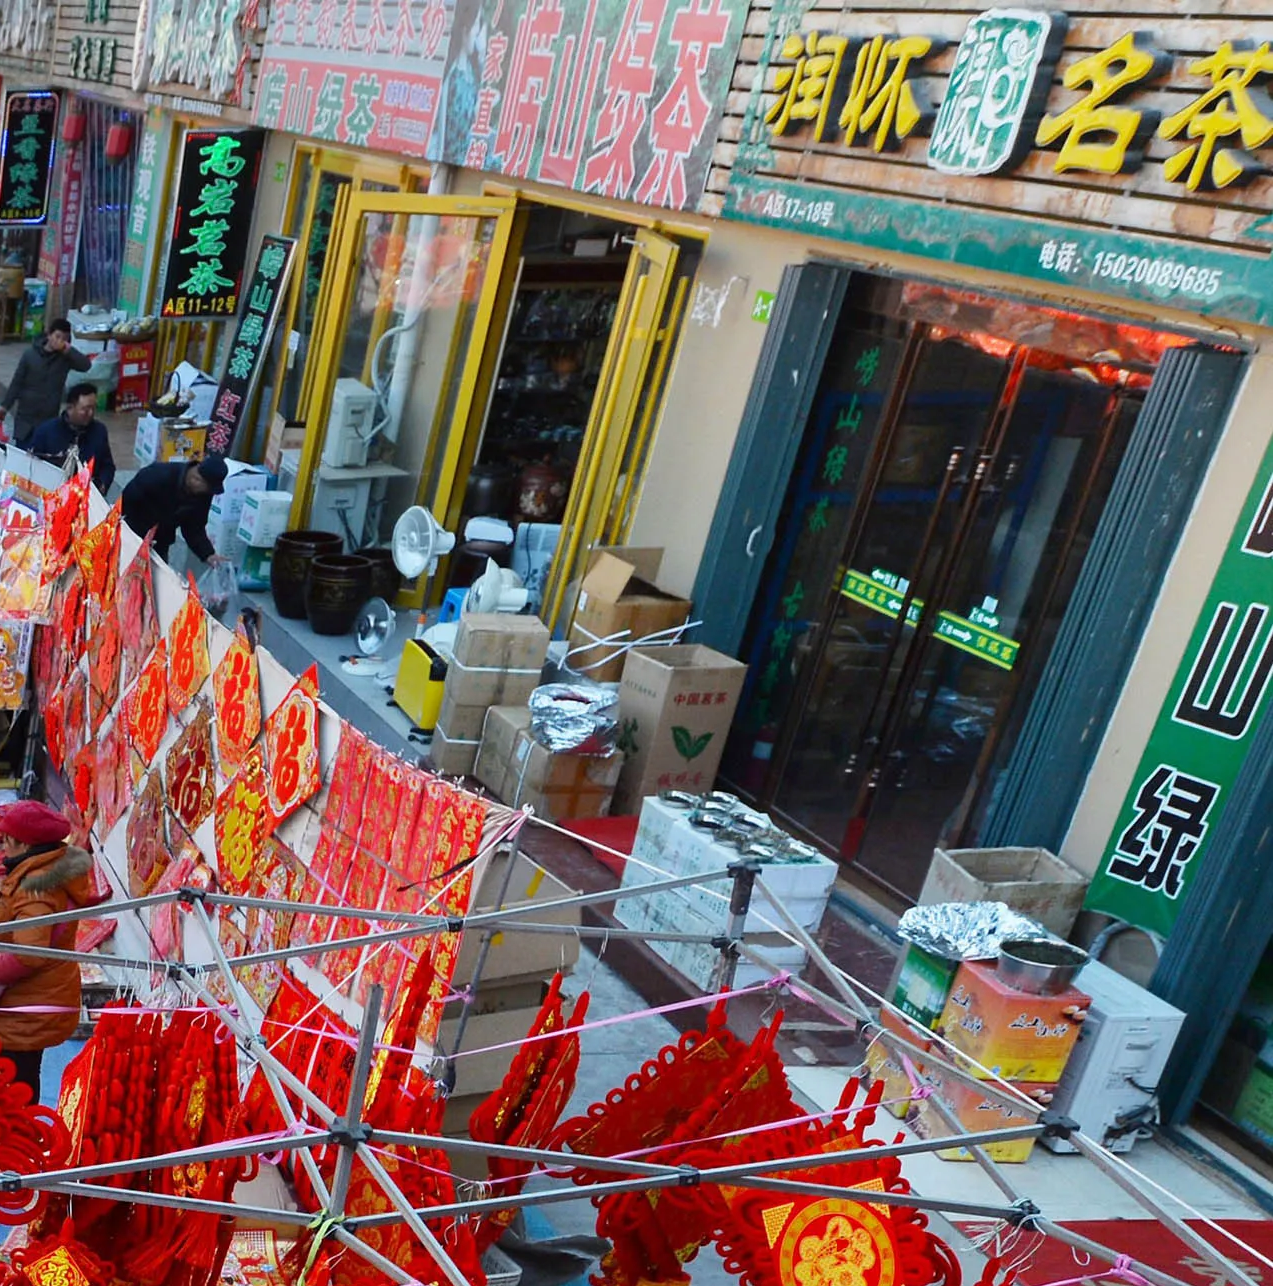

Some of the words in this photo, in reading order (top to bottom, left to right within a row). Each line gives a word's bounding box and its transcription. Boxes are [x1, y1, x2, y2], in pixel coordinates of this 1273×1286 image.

[1035, 31, 1273, 192] 名茶
[177, 135, 247, 297] 高岩茗茶
[762, 193, 835, 228] A区17-18号
[163, 296, 237, 317] A区11-12号
[1093, 251, 1222, 296] 15020089685
[271, 703, 307, 807] 福
